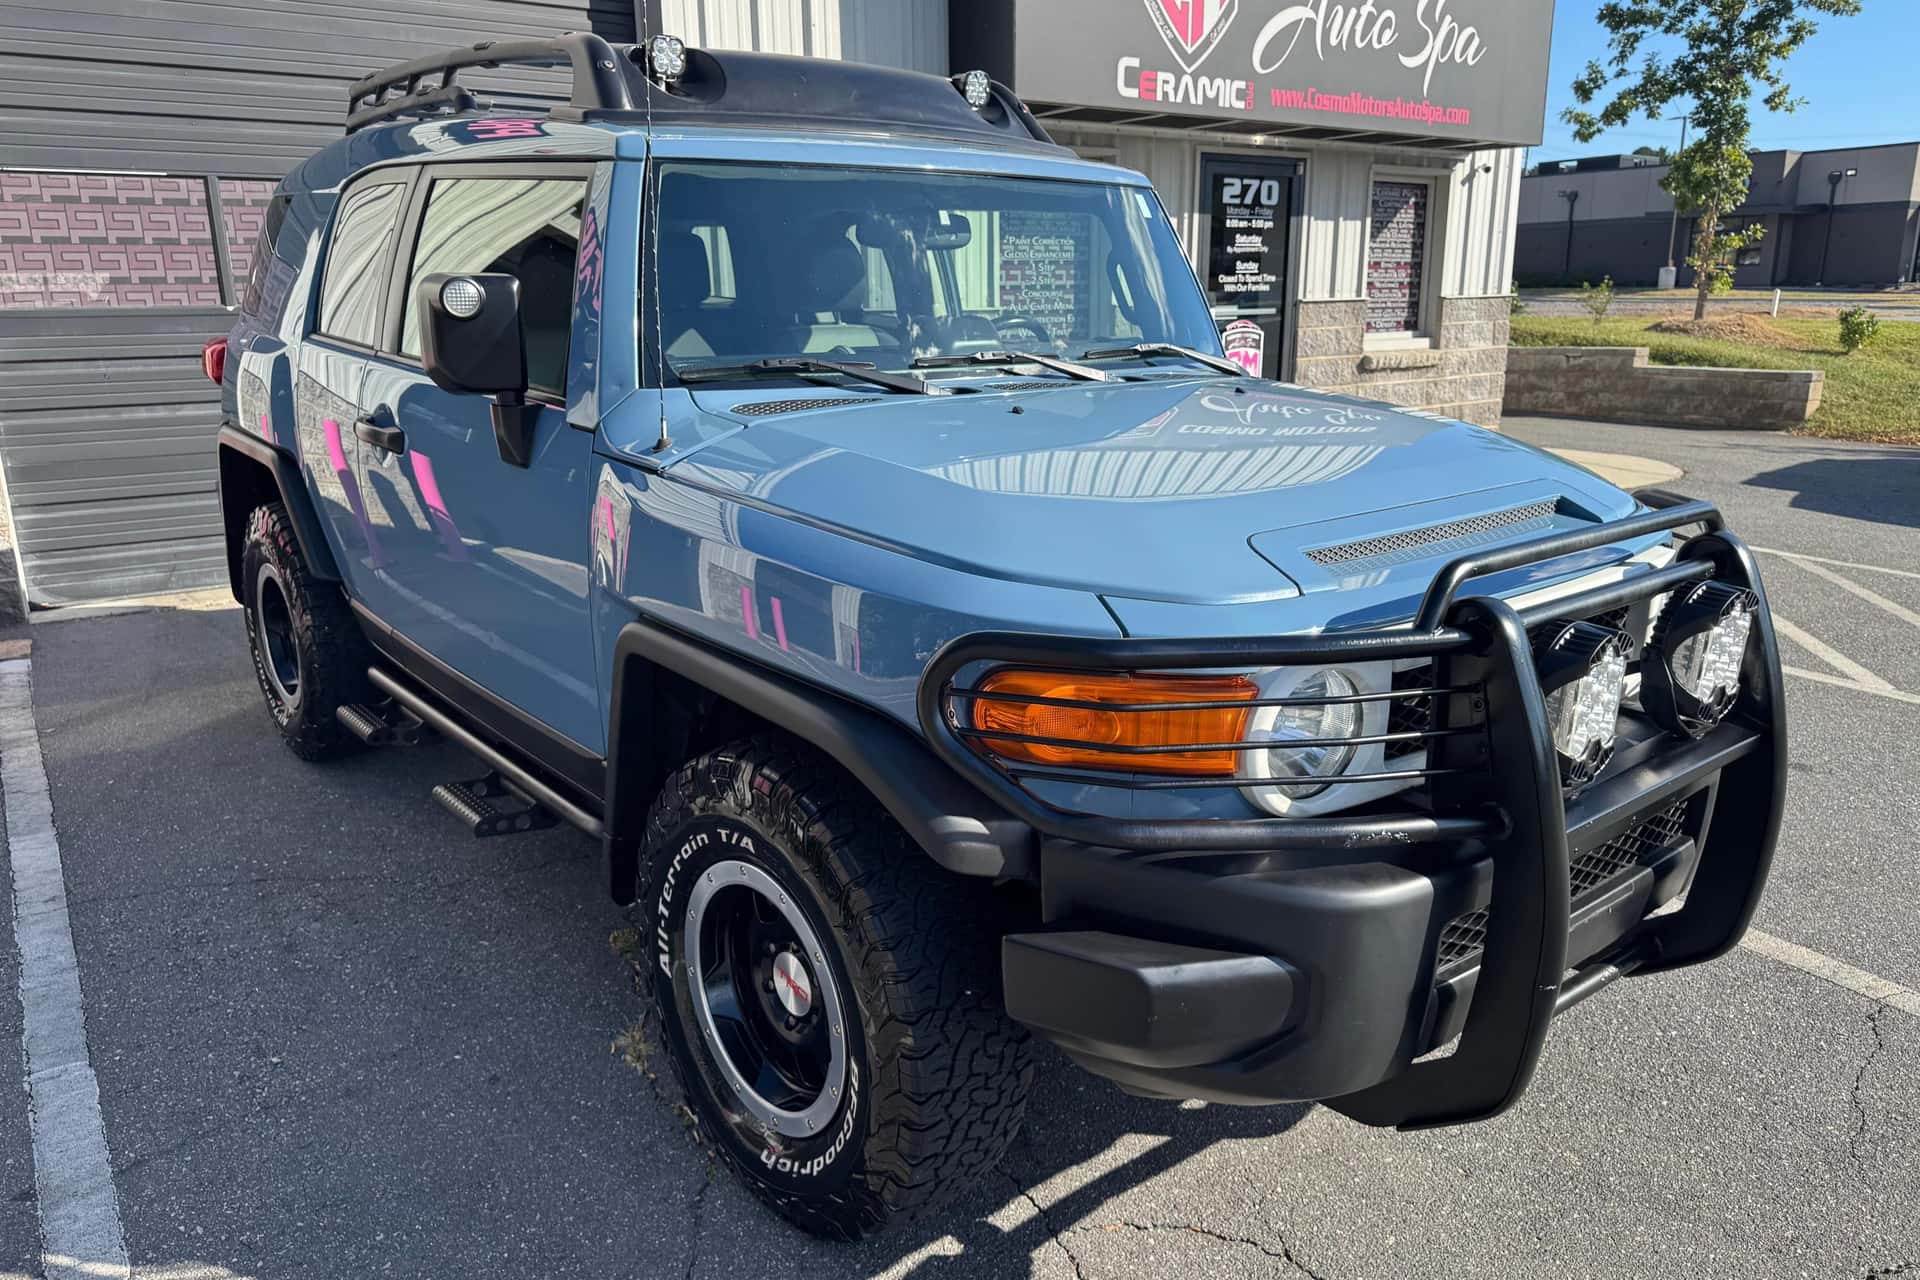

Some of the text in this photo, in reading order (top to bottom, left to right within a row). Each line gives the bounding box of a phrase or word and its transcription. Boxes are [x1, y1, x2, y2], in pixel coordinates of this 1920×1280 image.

[1252, 0, 1398, 74] Auto
[1398, 0, 1487, 98] Spa
[1117, 56, 1246, 109] CERAMIC
[1270, 87, 1471, 125] www.CosmoMotorsAutoSpa.com
[1222, 178, 1280, 206] 270
[1235, 233, 1263, 243] Saturday
[1218, 274, 1238, 283] Closed
[1236, 260, 1259, 270] Sunday
[657, 832, 710, 979] All-Terrain
[760, 1056, 859, 1177] BFGoodrich
